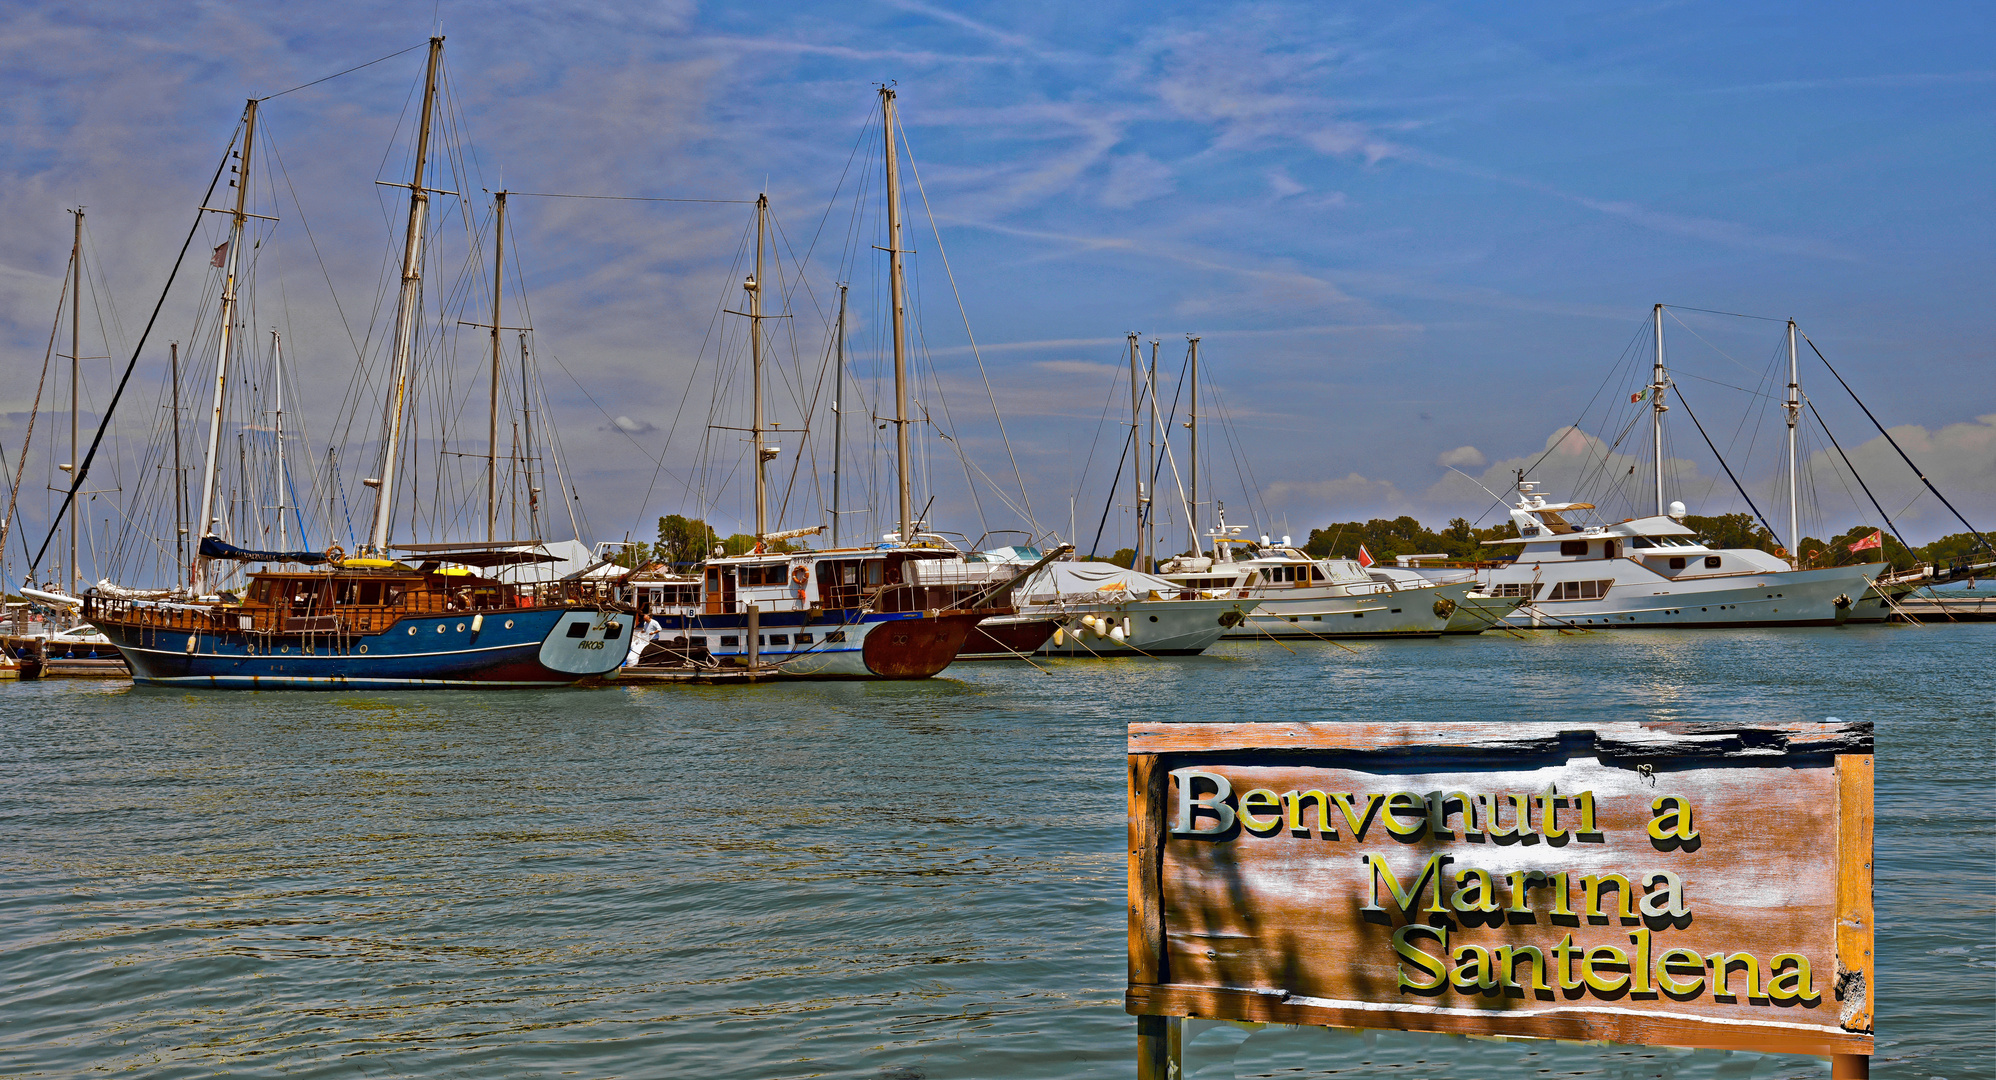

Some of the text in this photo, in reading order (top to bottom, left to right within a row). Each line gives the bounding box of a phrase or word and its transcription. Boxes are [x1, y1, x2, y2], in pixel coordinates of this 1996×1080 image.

[578, 640, 605, 650] AKOS
[1168, 771, 1701, 842] Benvenuti a
[1358, 851, 1691, 920] Marina
[1391, 923, 1822, 1002] Santelena
